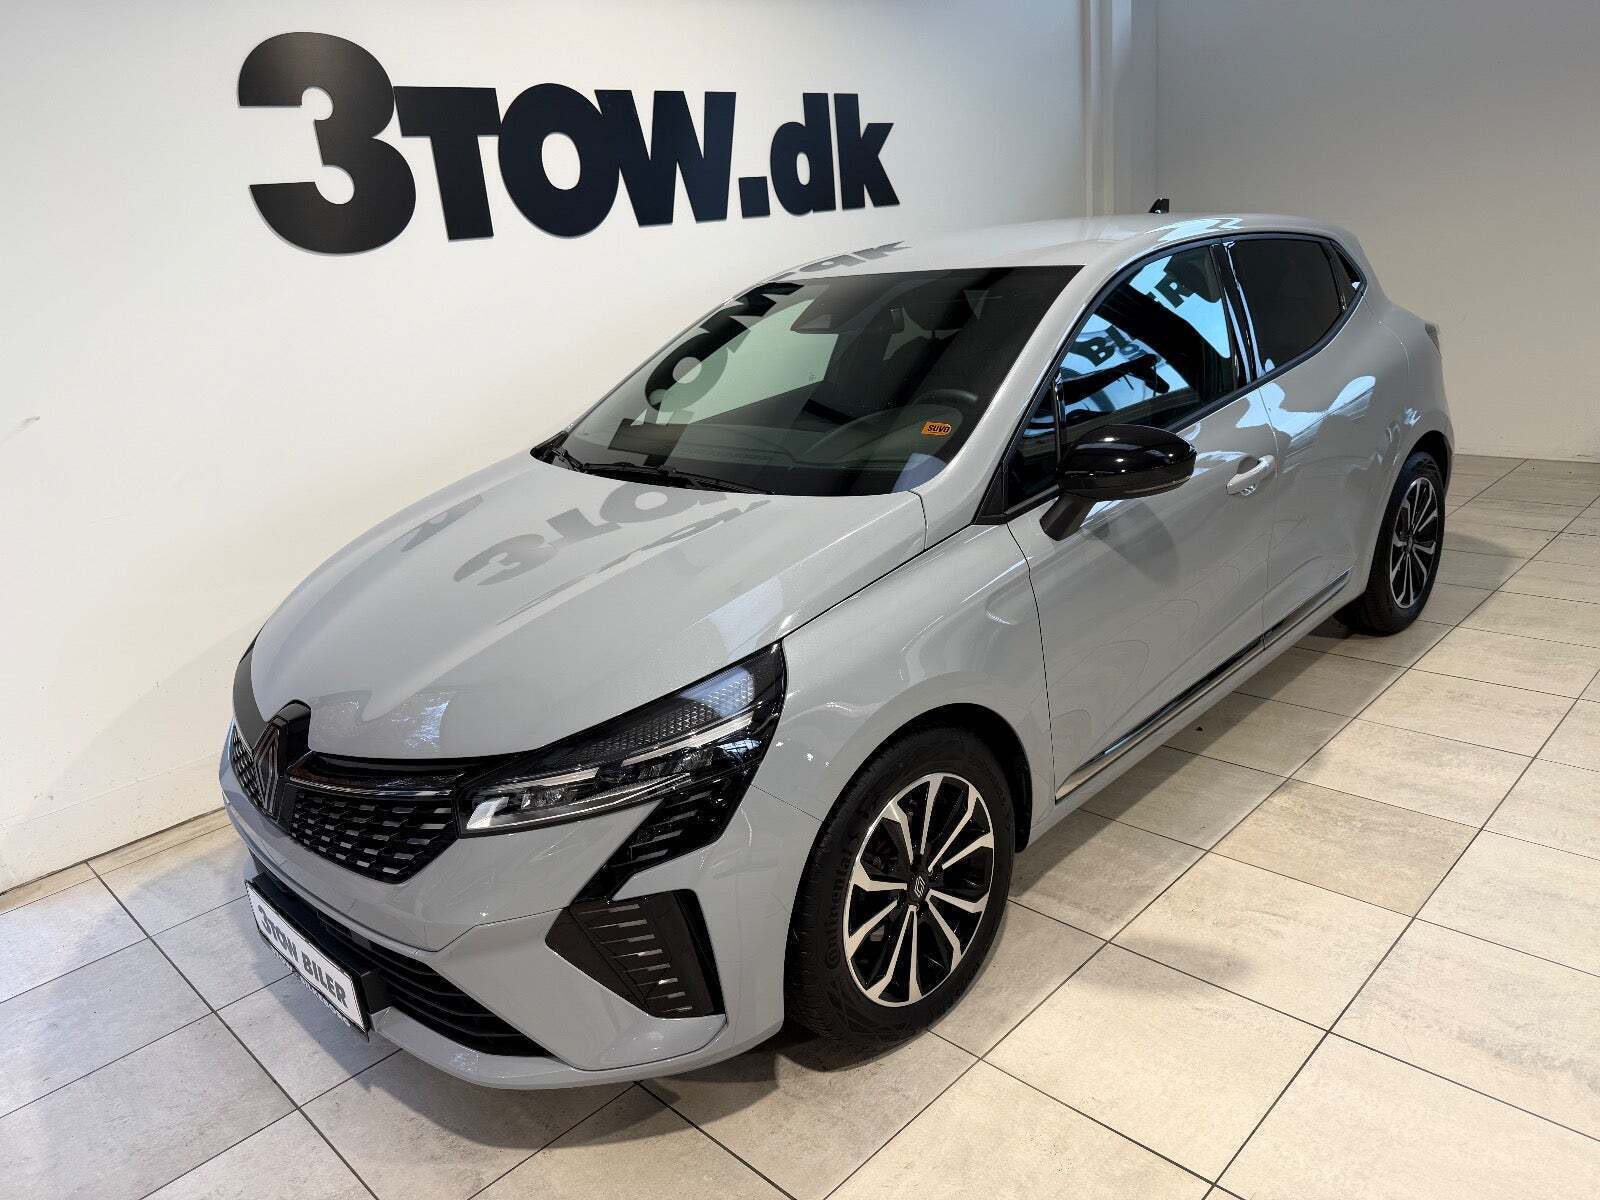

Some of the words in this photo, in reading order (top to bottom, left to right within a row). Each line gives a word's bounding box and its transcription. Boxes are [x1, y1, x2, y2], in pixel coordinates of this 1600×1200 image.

[238, 31, 900, 255] 3TOW.dk
[258, 904, 298, 962] 3TOW
[301, 951, 348, 1009] BILER
